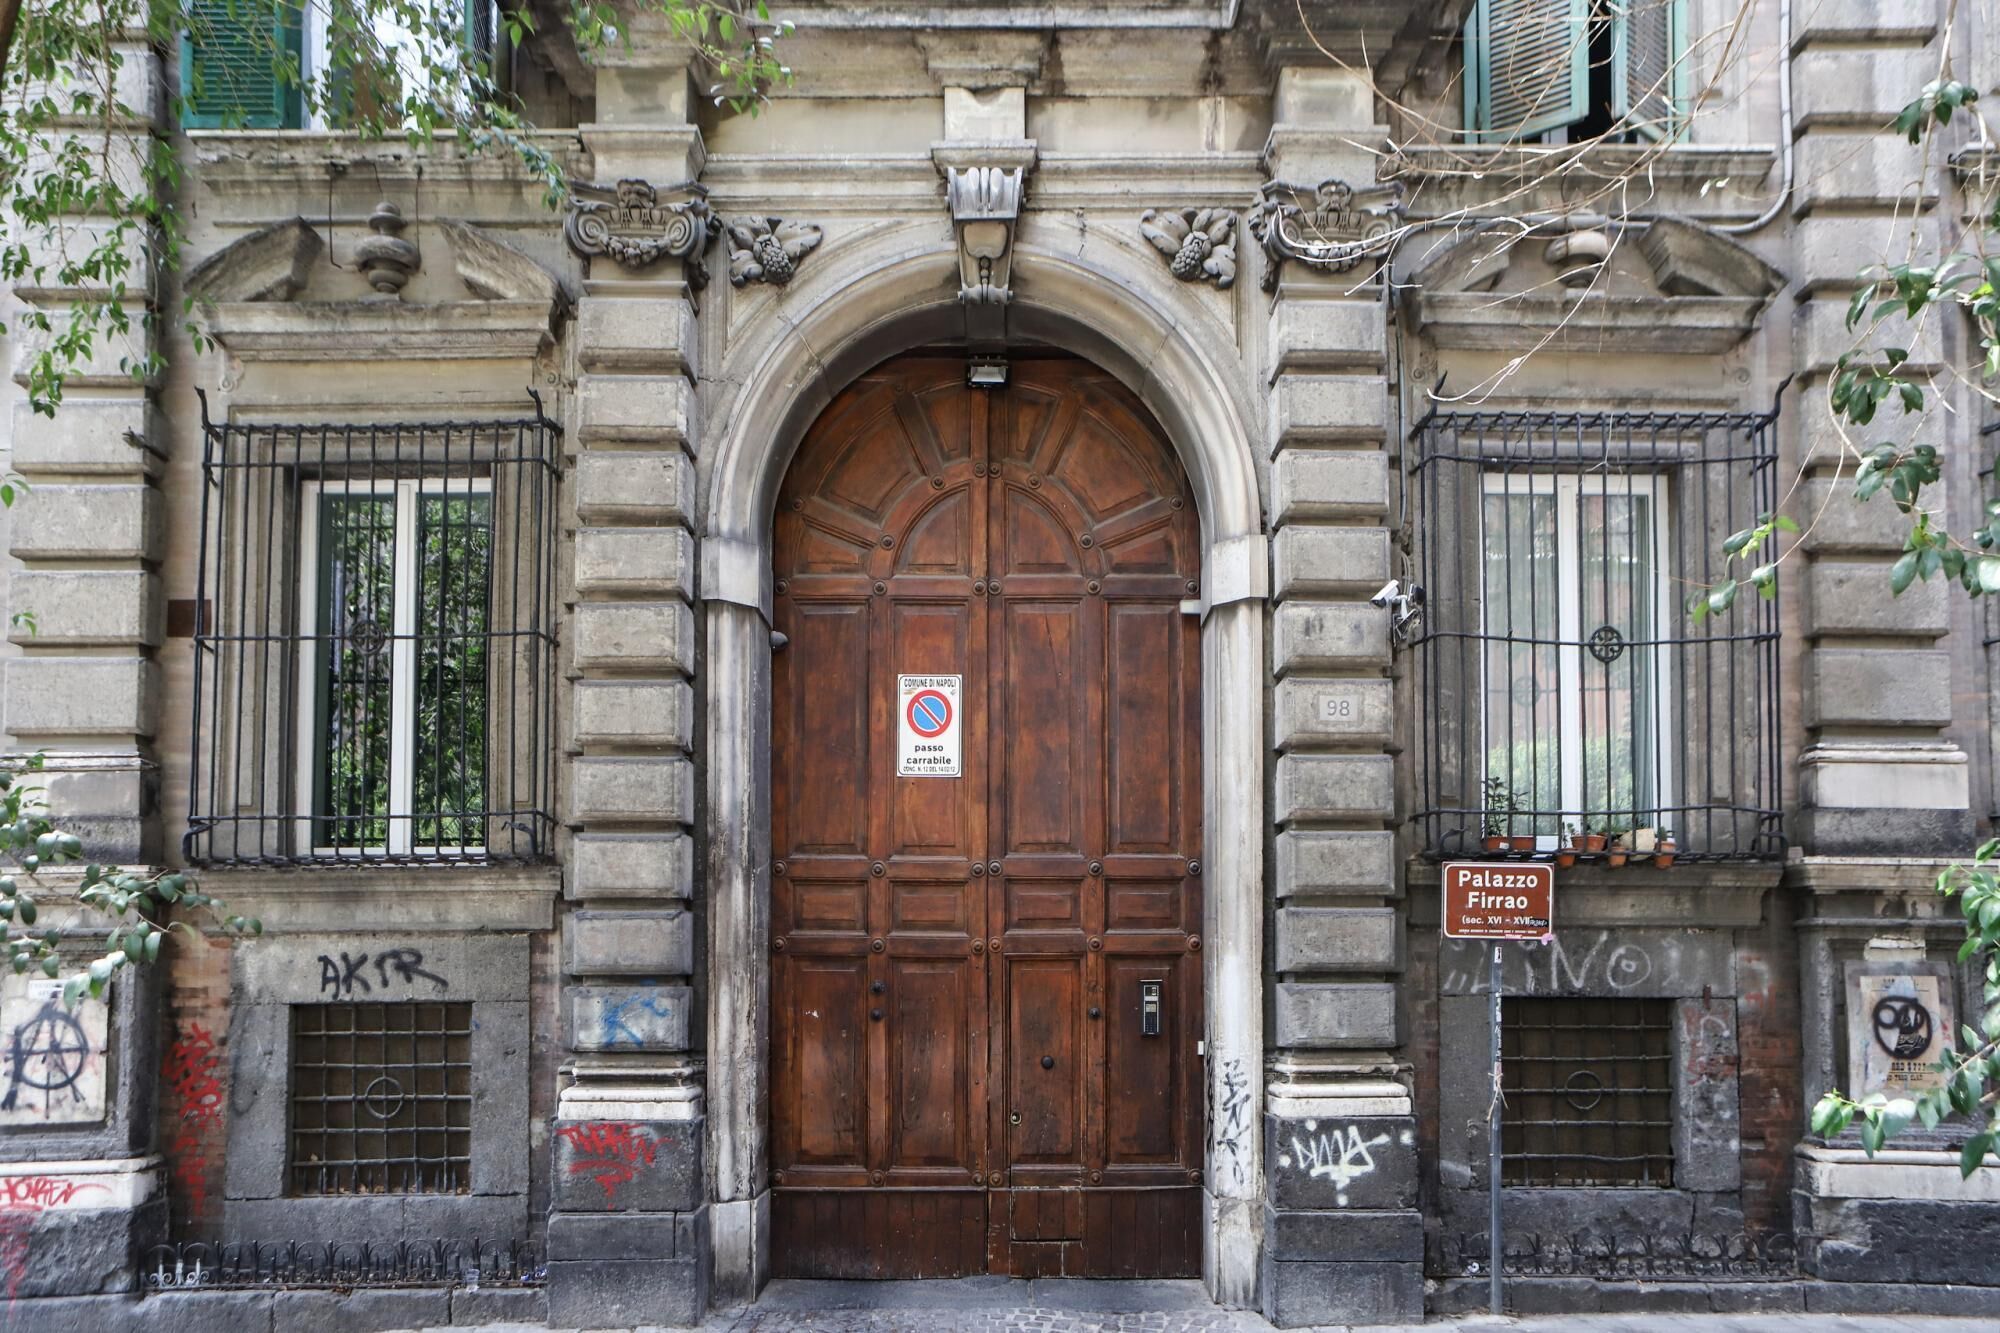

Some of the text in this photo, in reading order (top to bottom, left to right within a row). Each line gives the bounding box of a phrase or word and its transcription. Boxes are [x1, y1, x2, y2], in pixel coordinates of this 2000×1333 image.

[904, 678, 957, 688] COMUNE DI NAPOLI
[1327, 700, 1350, 716] 98
[914, 744, 944, 753] passo
[906, 756, 952, 765] carrabile
[1458, 869, 1538, 888] Palazzo
[1467, 892, 1529, 909] Firrao
[1461, 914, 1484, 925] (sec.
[1487, 915, 1502, 925] XVI
